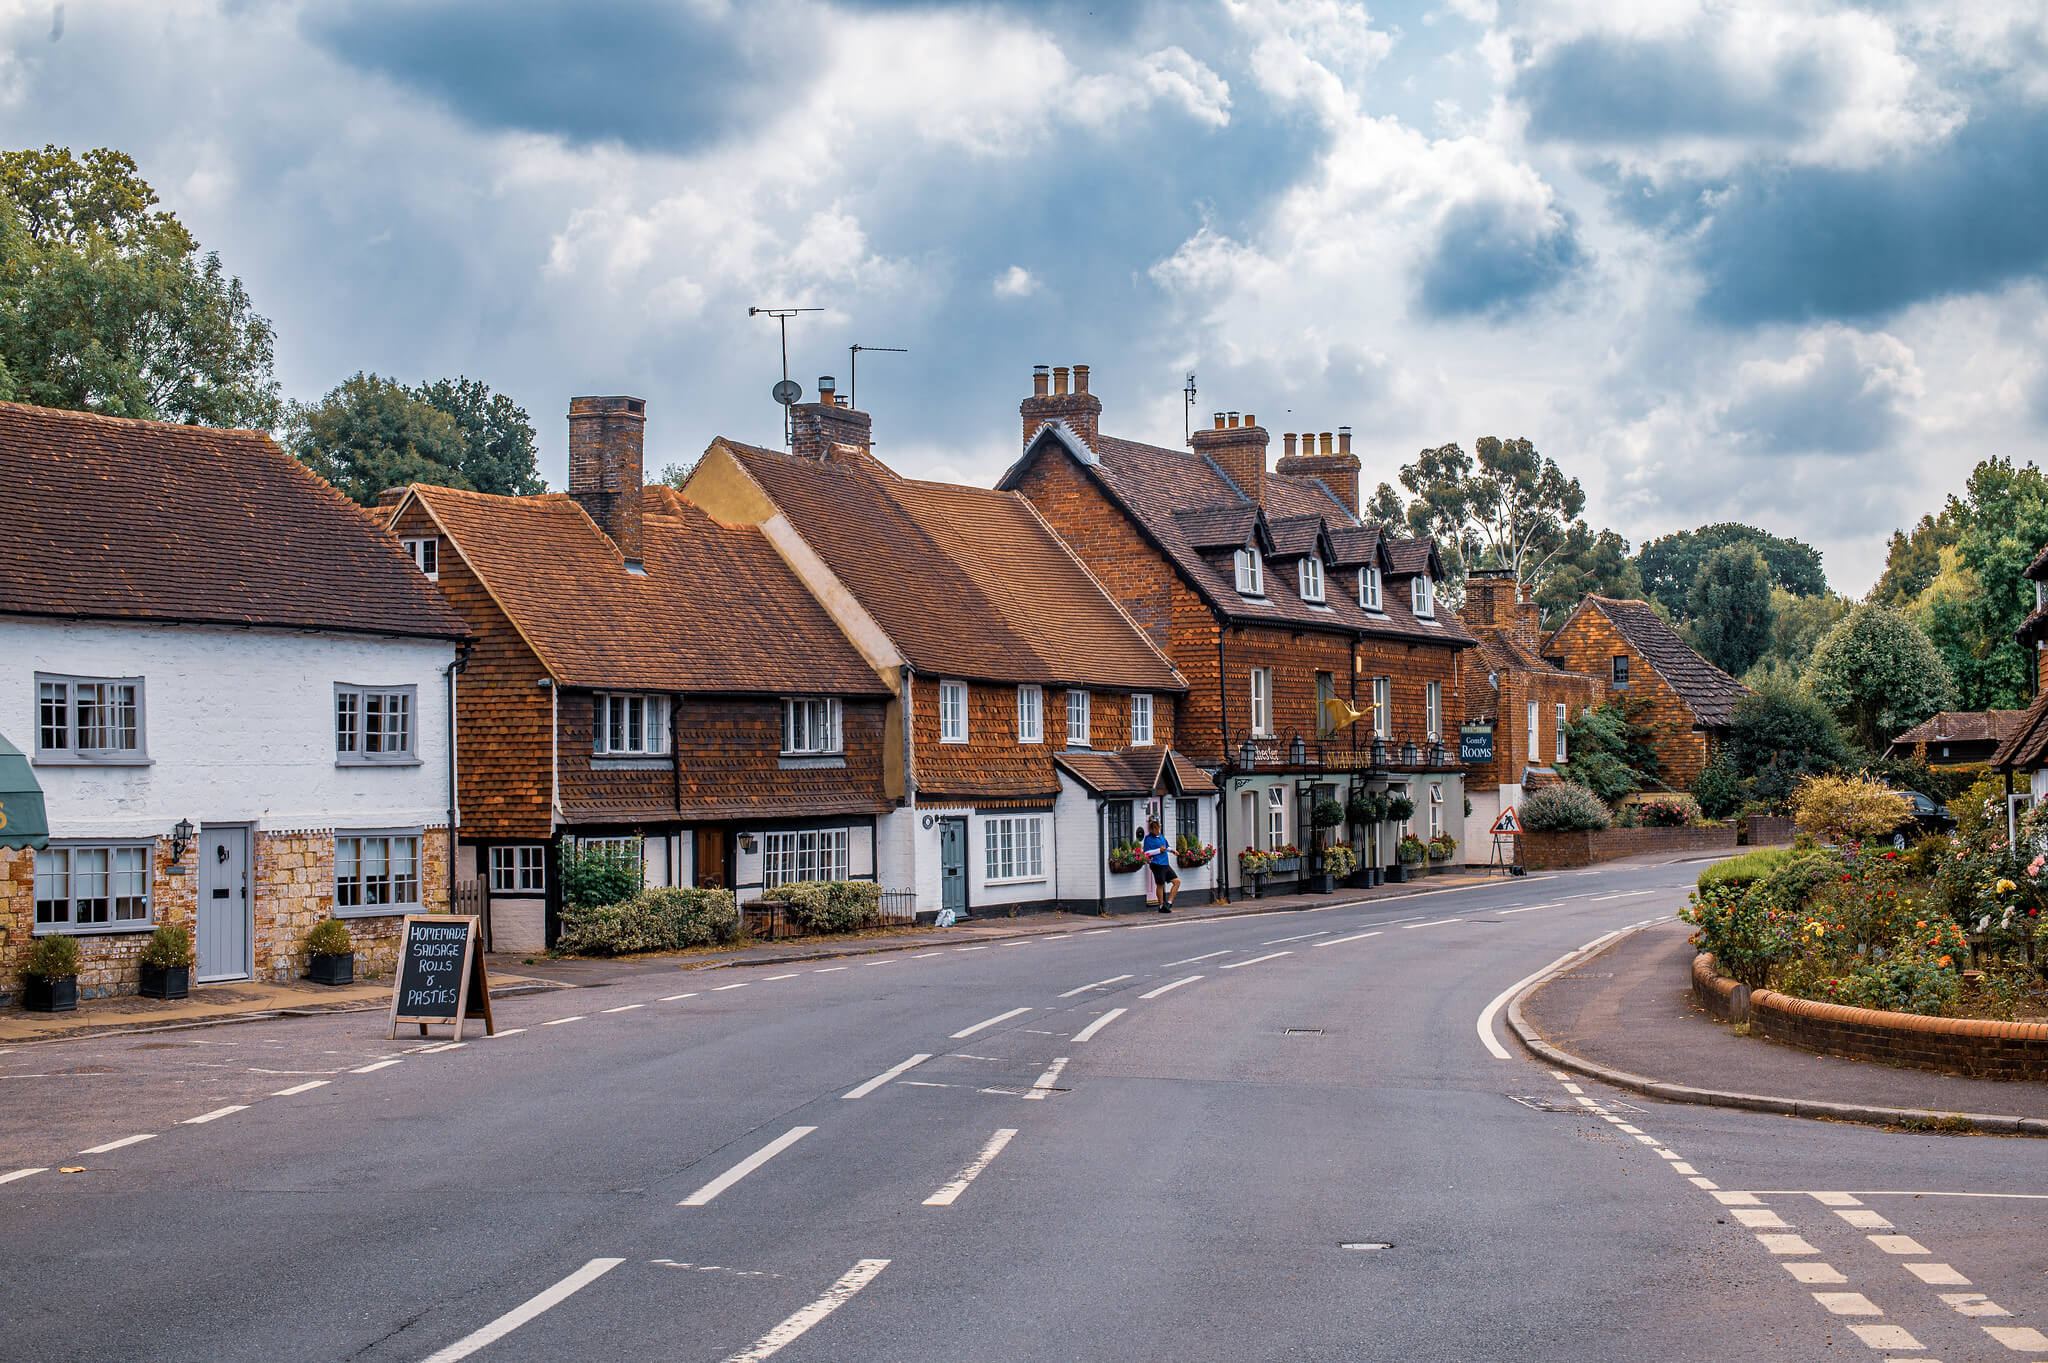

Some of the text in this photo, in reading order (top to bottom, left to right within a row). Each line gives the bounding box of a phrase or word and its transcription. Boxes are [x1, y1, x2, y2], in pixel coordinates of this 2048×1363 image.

[1465, 736, 1487, 746] Comfy
[1462, 745, 1492, 758] ROOMS
[1327, 751, 1371, 769] SWAN INN
[410, 926, 468, 941] HOMEMADE
[413, 943, 460, 957] SAUSAGE
[418, 959, 453, 973] ROLLS
